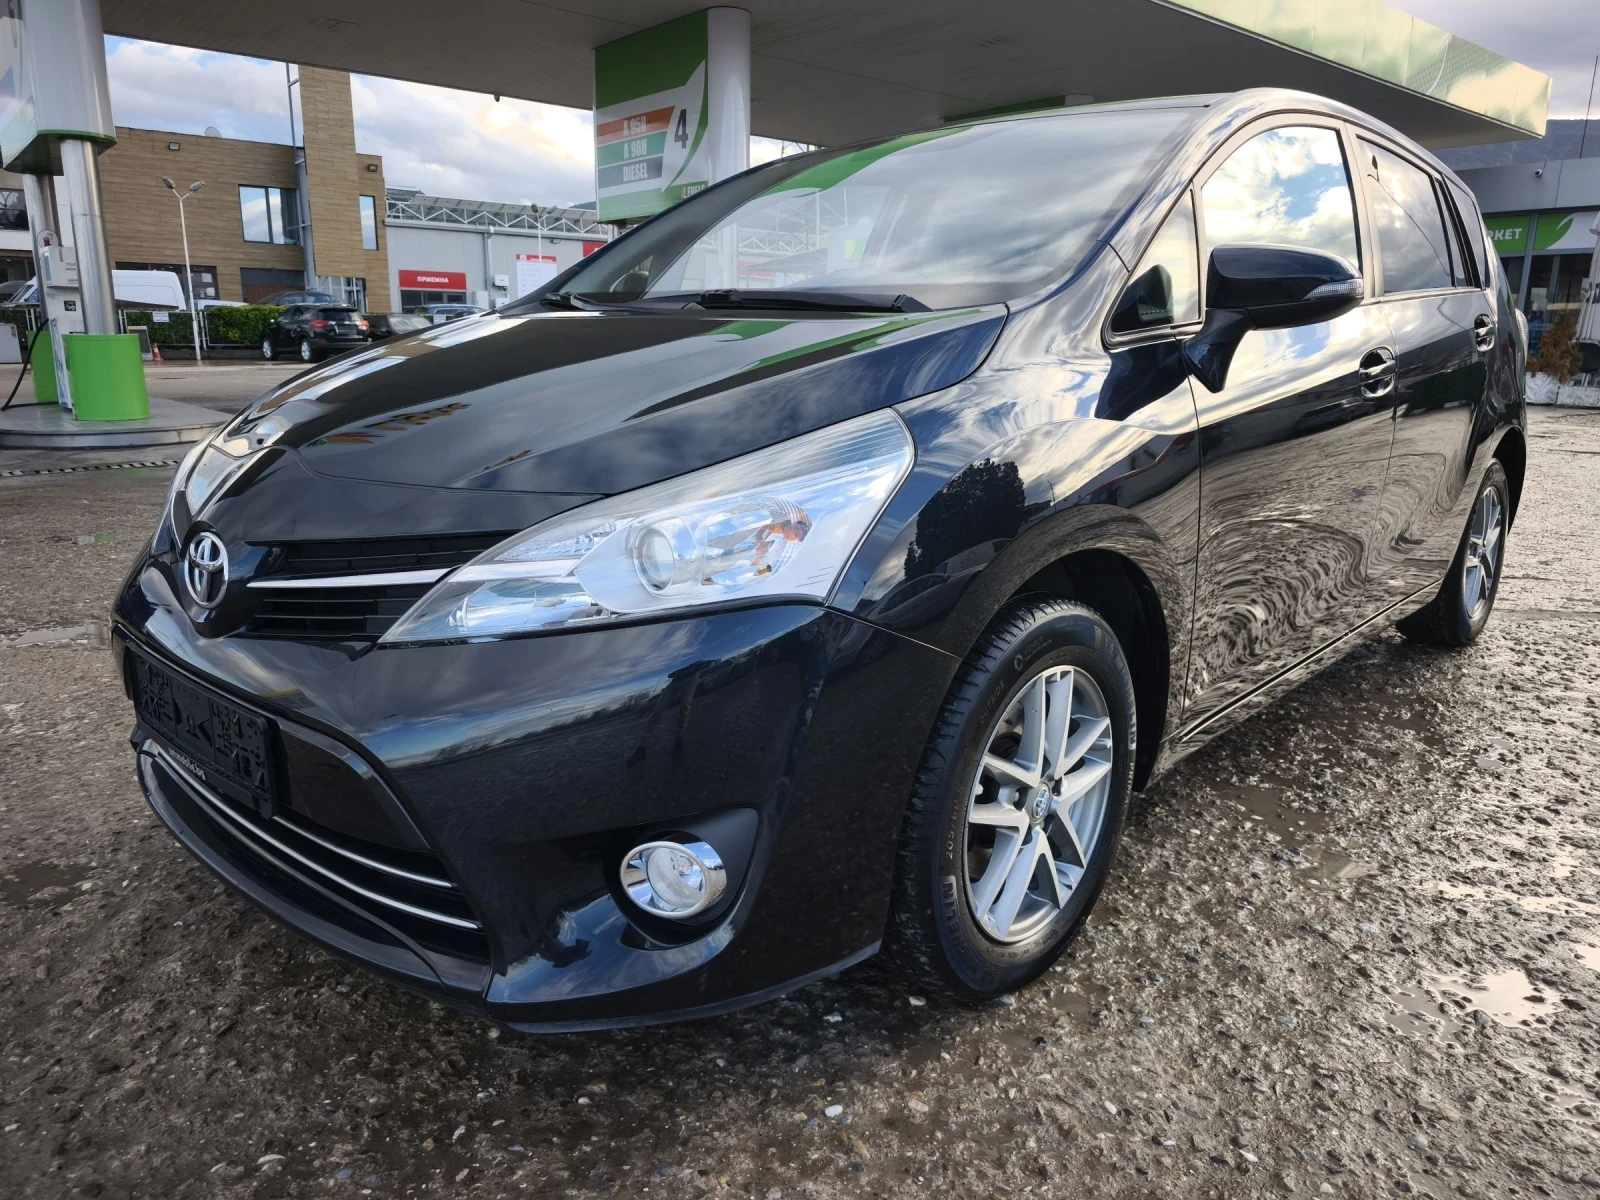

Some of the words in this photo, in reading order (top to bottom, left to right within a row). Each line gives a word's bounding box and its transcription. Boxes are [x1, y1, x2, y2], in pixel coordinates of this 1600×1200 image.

[674, 108, 689, 149] 4
[623, 162, 648, 182] DIESEL
[416, 275, 450, 284] ПРИЕМНА
[979, 678, 1005, 724] OUTSIDE
